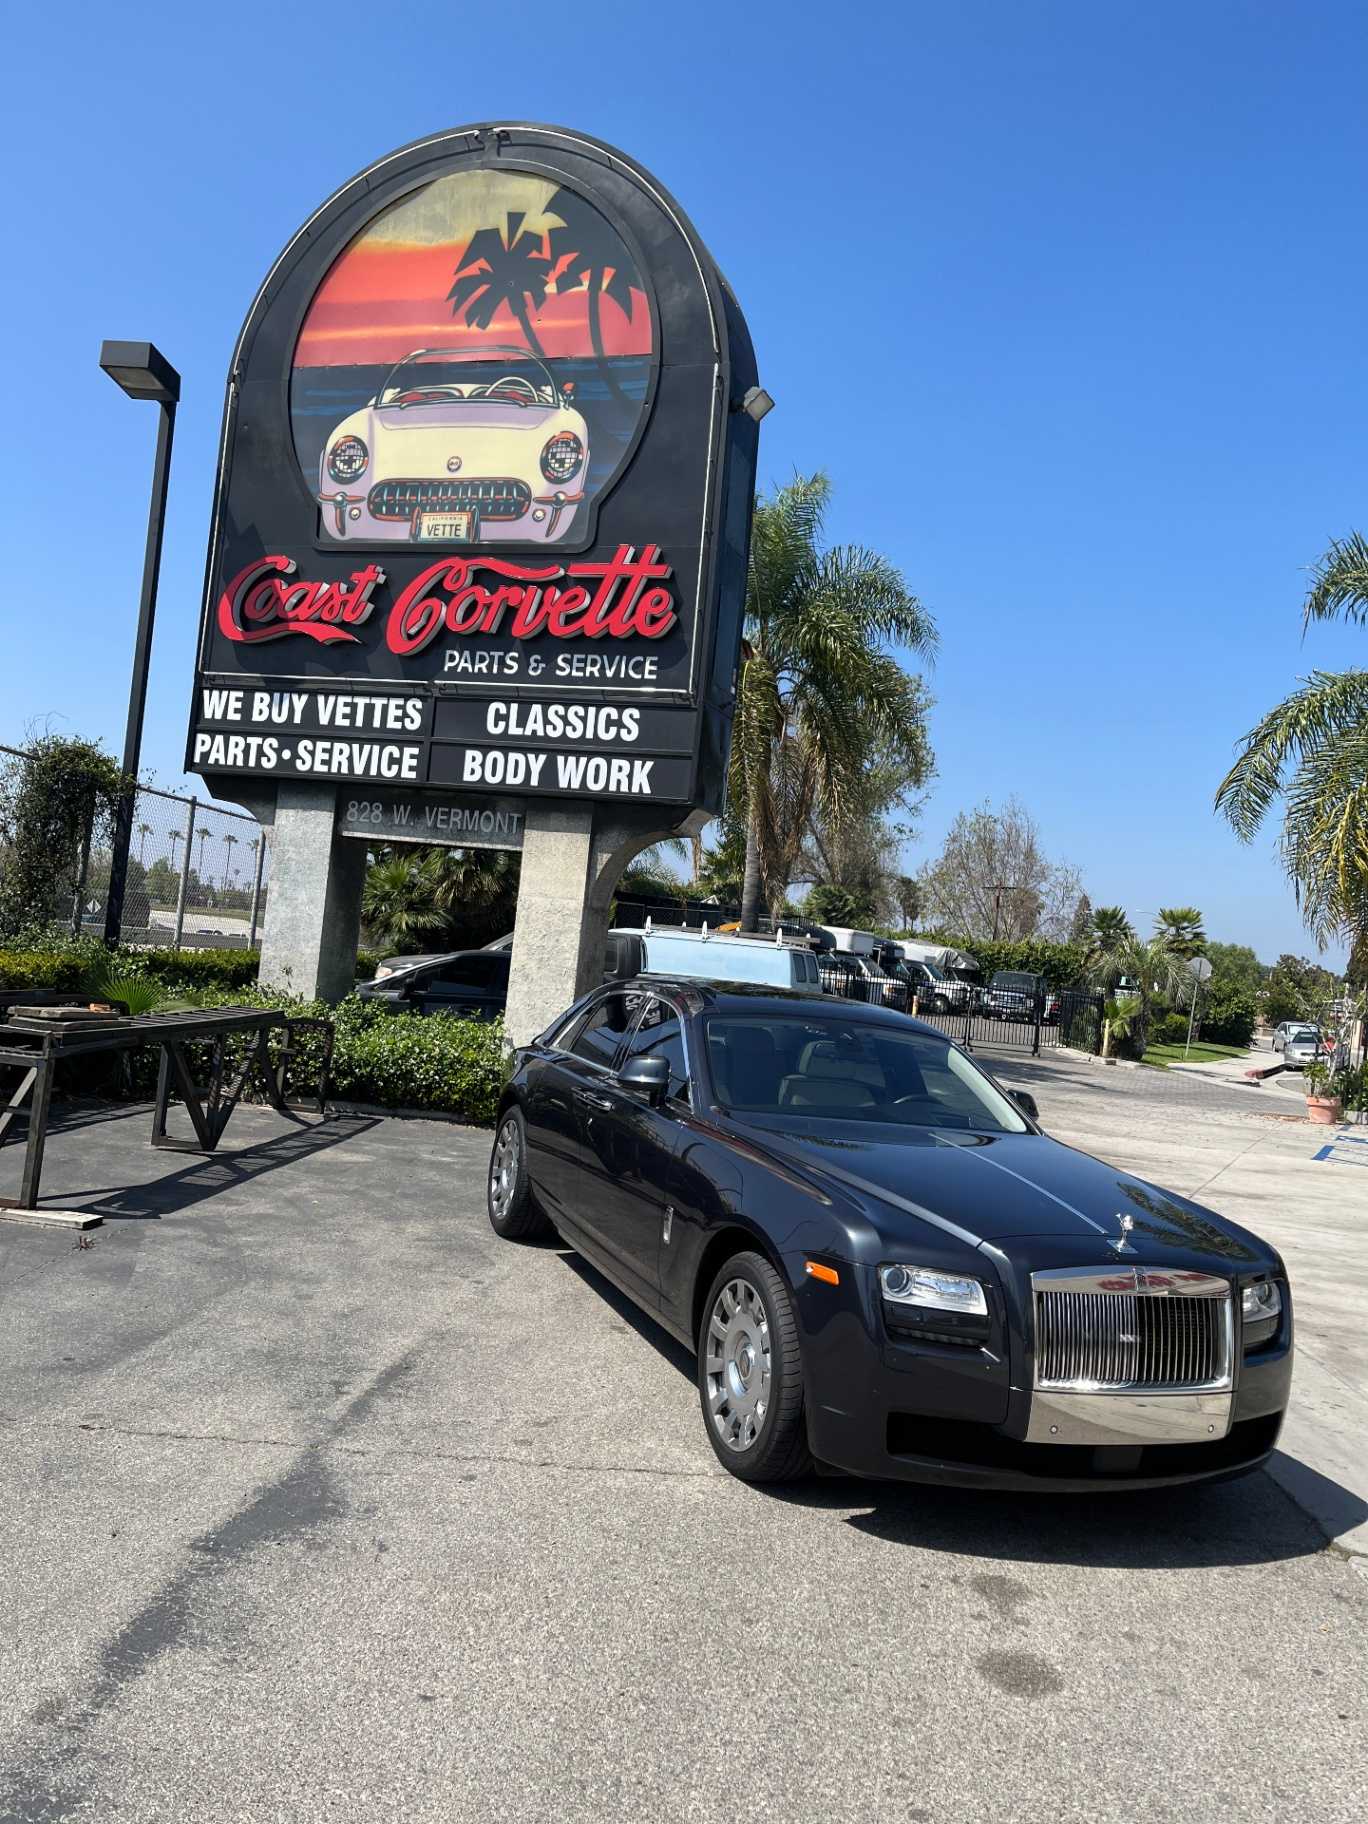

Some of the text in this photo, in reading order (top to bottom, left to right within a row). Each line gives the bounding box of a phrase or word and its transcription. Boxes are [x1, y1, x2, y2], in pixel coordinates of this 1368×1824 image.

[427, 524, 462, 537] VETTE
[218, 543, 677, 656] Coast Corvette
[444, 649, 659, 680] PARTS & SERVICE
[202, 689, 423, 731] WE BUY VETTES
[486, 701, 640, 742] CLASSICS
[463, 749, 655, 794] BODY WORK
[346, 800, 522, 834] 828 W. VERMONT
